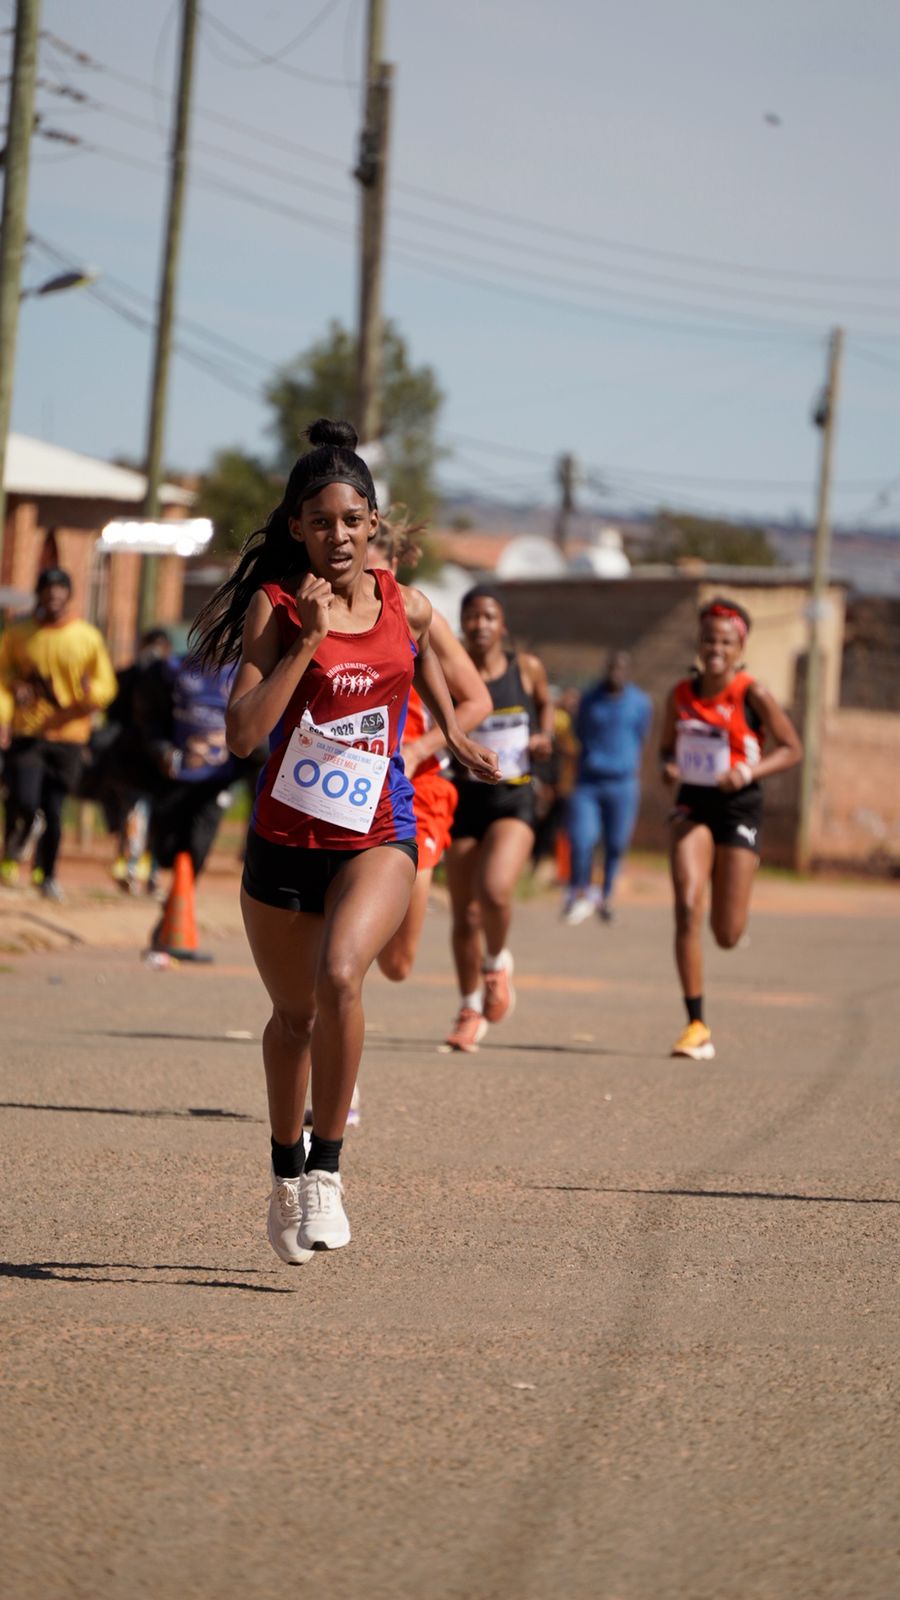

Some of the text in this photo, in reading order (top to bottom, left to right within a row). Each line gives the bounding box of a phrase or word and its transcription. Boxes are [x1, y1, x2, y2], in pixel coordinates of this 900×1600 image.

[362, 714, 383, 728] ASA
[330, 722, 355, 736] 2026
[322, 753, 343, 766] STREET
[344, 760, 358, 770] MILE
[293, 758, 372, 807] 008
